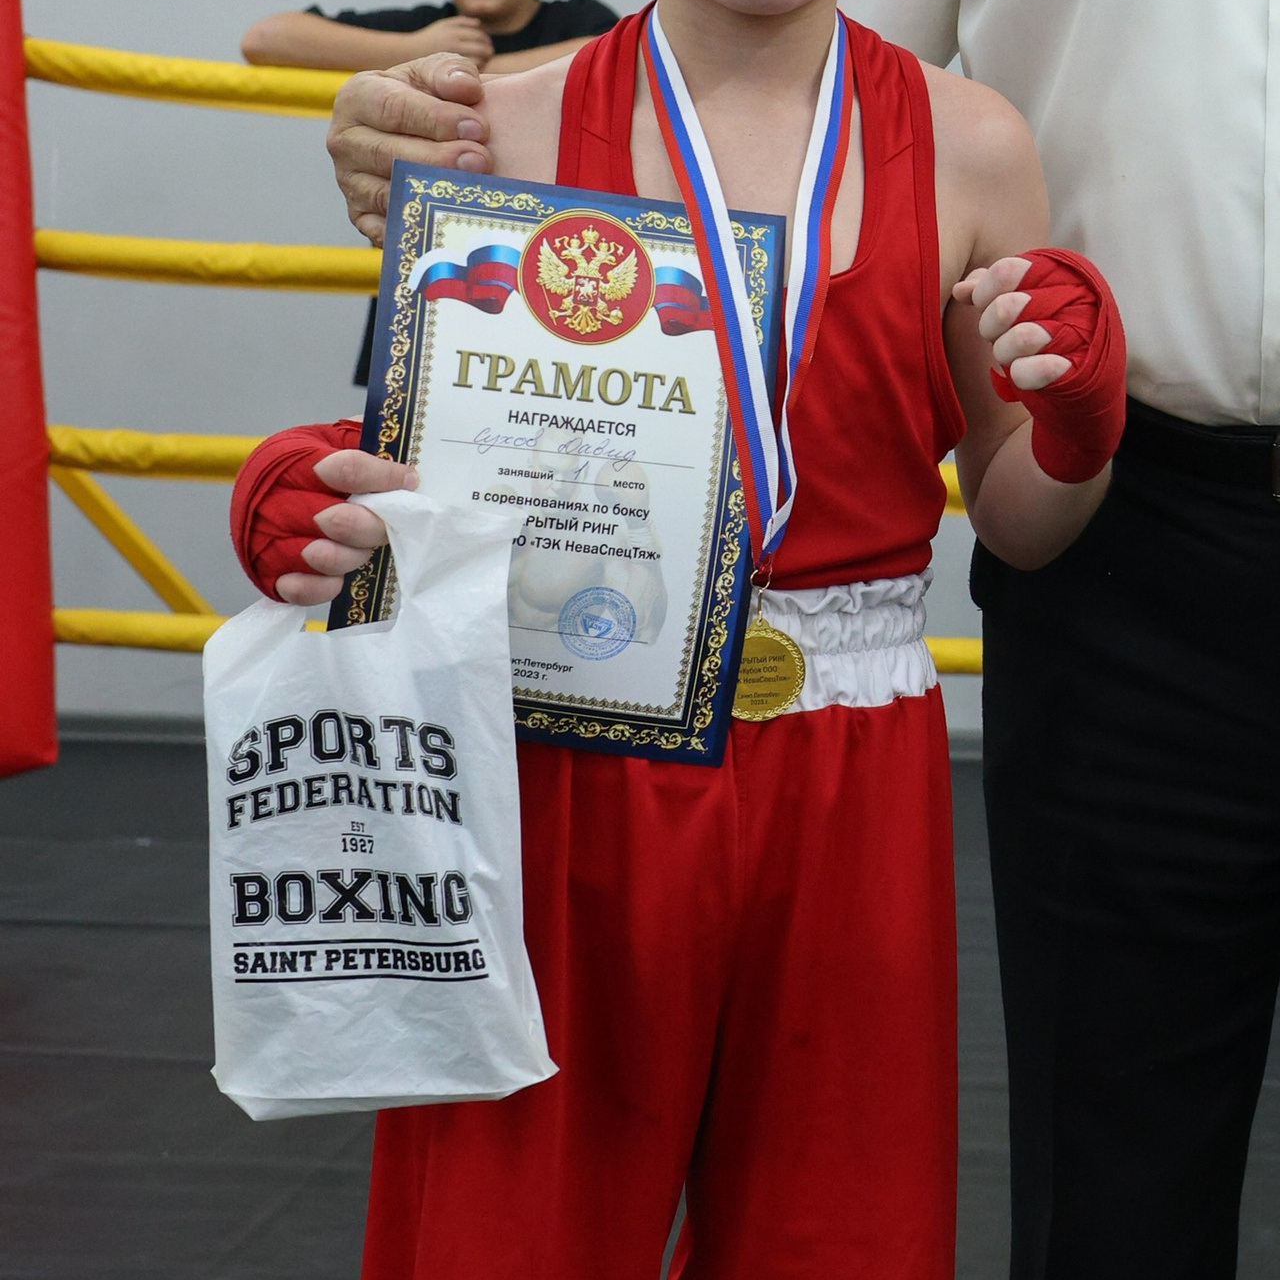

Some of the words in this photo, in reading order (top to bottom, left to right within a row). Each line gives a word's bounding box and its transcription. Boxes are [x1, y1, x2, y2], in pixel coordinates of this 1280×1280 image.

[452, 350, 696, 415] ГРАМОТА
[508, 410, 636, 437] НАГРАЖДАЕТСЯ
[473, 427, 543, 454] Сухов
[558, 438, 636, 471] Давид
[498, 467, 554, 481] занявший
[612, 479, 645, 490] место
[472, 491, 480, 501] в
[484, 492, 589, 512] соревнованиях
[593, 504, 609, 514] по
[612, 503, 650, 521] боксу
[525, 515, 579, 532] РЫТЫЙ
[582, 520, 619, 535] РИНГ
[511, 658, 574, 673] кт-Петербург
[513, 668, 540, 680] 2023
[226, 708, 459, 786] SPORTS
[226, 772, 463, 830] FEDERATION
[350, 822, 366, 833] EST
[341, 837, 375, 855] 1927
[230, 868, 474, 927] BOXING
[233, 948, 317, 974] SAINT
[325, 947, 487, 973] PETERSBURG
